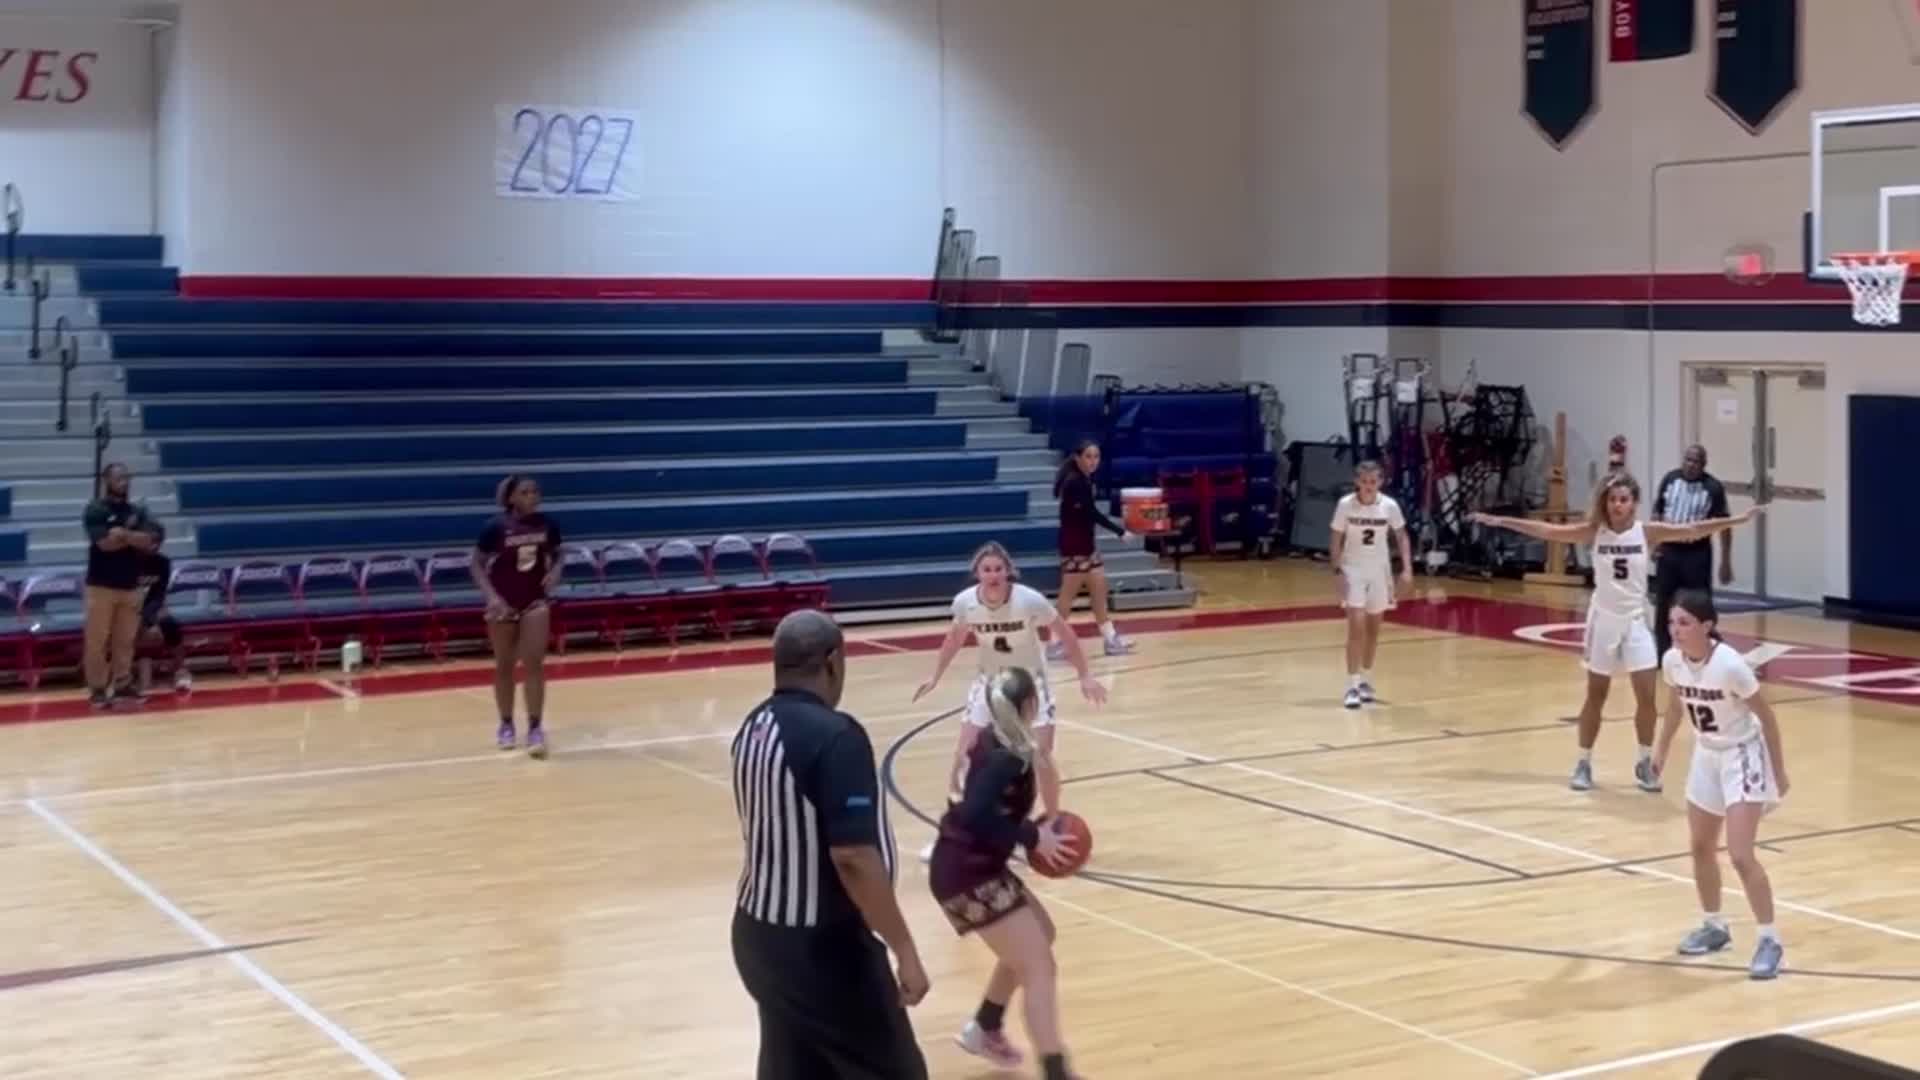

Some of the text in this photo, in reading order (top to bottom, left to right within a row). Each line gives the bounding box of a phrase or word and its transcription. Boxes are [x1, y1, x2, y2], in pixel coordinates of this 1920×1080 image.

[510, 108, 634, 194] 2027
[1362, 528, 1375, 546] 2
[516, 545, 538, 572] 5
[1613, 558, 1629, 580] 5
[993, 635, 1013, 654] 4
[1686, 702, 1719, 733] 12
